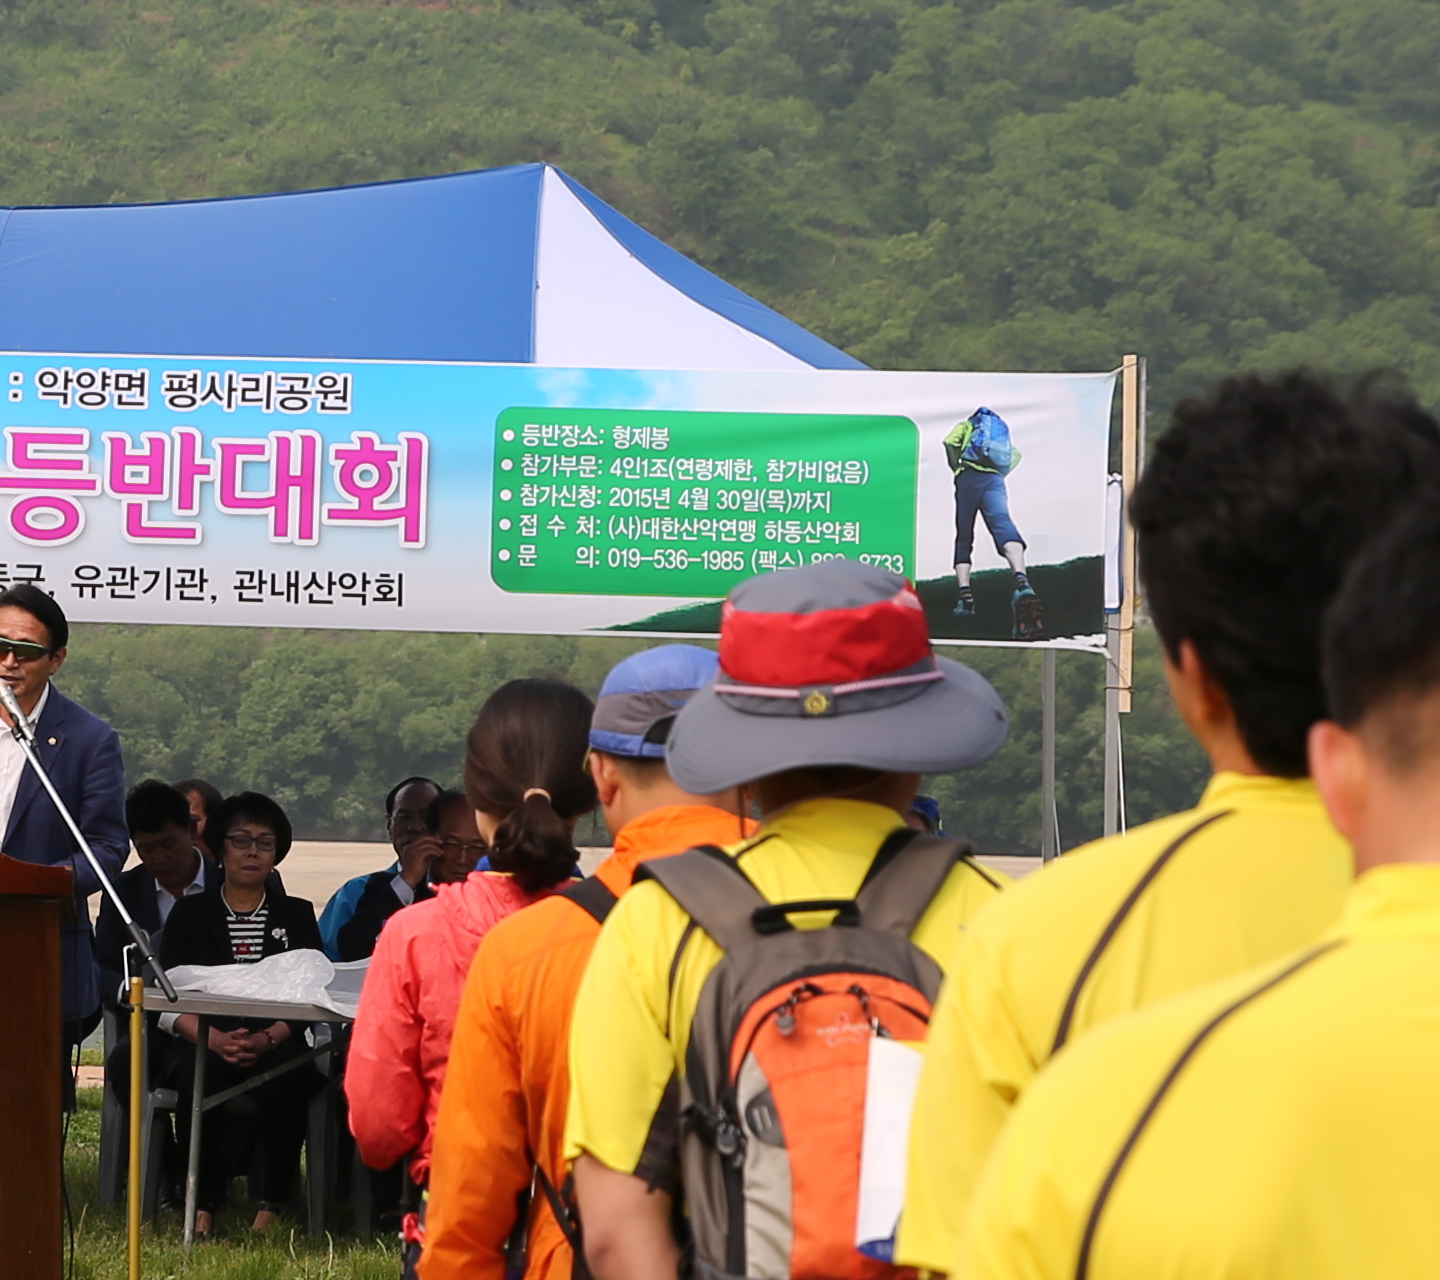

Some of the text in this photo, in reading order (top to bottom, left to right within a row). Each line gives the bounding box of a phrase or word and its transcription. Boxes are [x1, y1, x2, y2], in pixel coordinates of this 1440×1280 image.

[38, 369, 147, 407] 악양면
[164, 373, 349, 412] 평사리공원
[521, 423, 670, 450] 등반장소: 형제봉
[520, 453, 603, 478] 참가부문:
[766, 459, 869, 485] 참가비없음)
[519, 483, 831, 514] 참가신청: 2015년 4월 30일(목)까지
[608, 514, 757, 543] (사)대한산악연맹
[764, 520, 860, 545] 하동산악회
[608, 548, 745, 571] 019-536-1985
[70, 565, 218, 604] 유관기관,
[234, 569, 405, 607] 관내산악회
